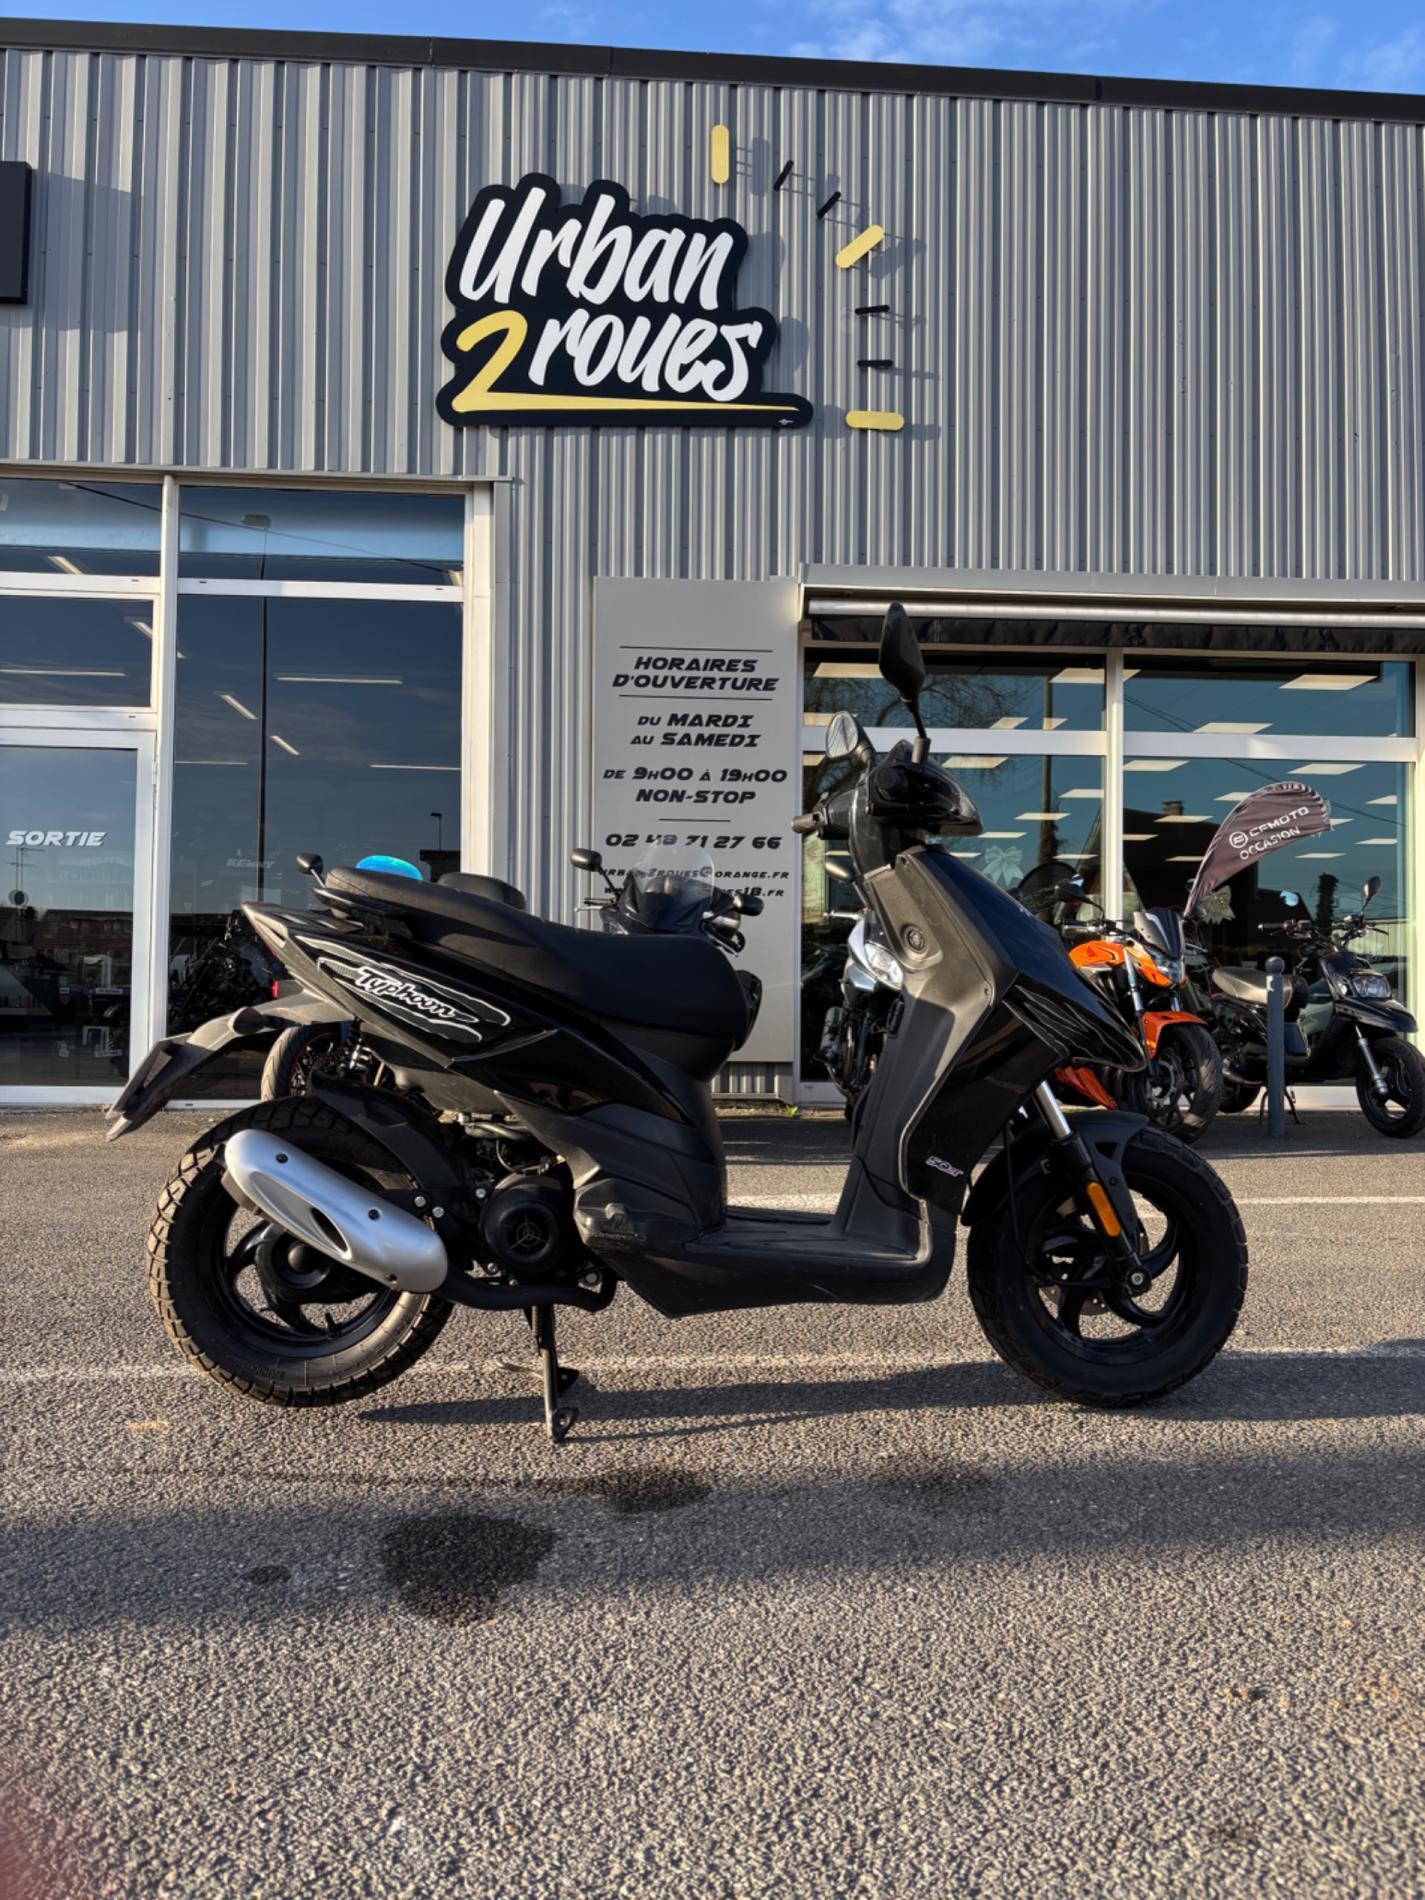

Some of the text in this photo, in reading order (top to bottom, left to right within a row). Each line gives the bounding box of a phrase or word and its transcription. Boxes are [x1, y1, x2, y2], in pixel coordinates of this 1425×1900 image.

[459, 187, 734, 310] Urban
[528, 308, 763, 402] roues
[634, 656, 758, 673] HORAIRES
[612, 674, 780, 691] D'OUVERTURE
[637, 713, 754, 728] DU MARDI
[630, 732, 761, 747] AU SAMEDI
[603, 769, 626, 779] DE
[635, 789, 756, 804] NON-STOP
[1249, 806, 1310, 837] CFMOTO
[6, 830, 106, 846] SORTIE
[605, 833, 640, 847] 02
[684, 835, 709, 848] 71
[713, 836, 746, 849] 27
[752, 836, 782, 849] 66
[1239, 826, 1301, 860] OCCASION
[354, 965, 458, 1019] Typhoon
